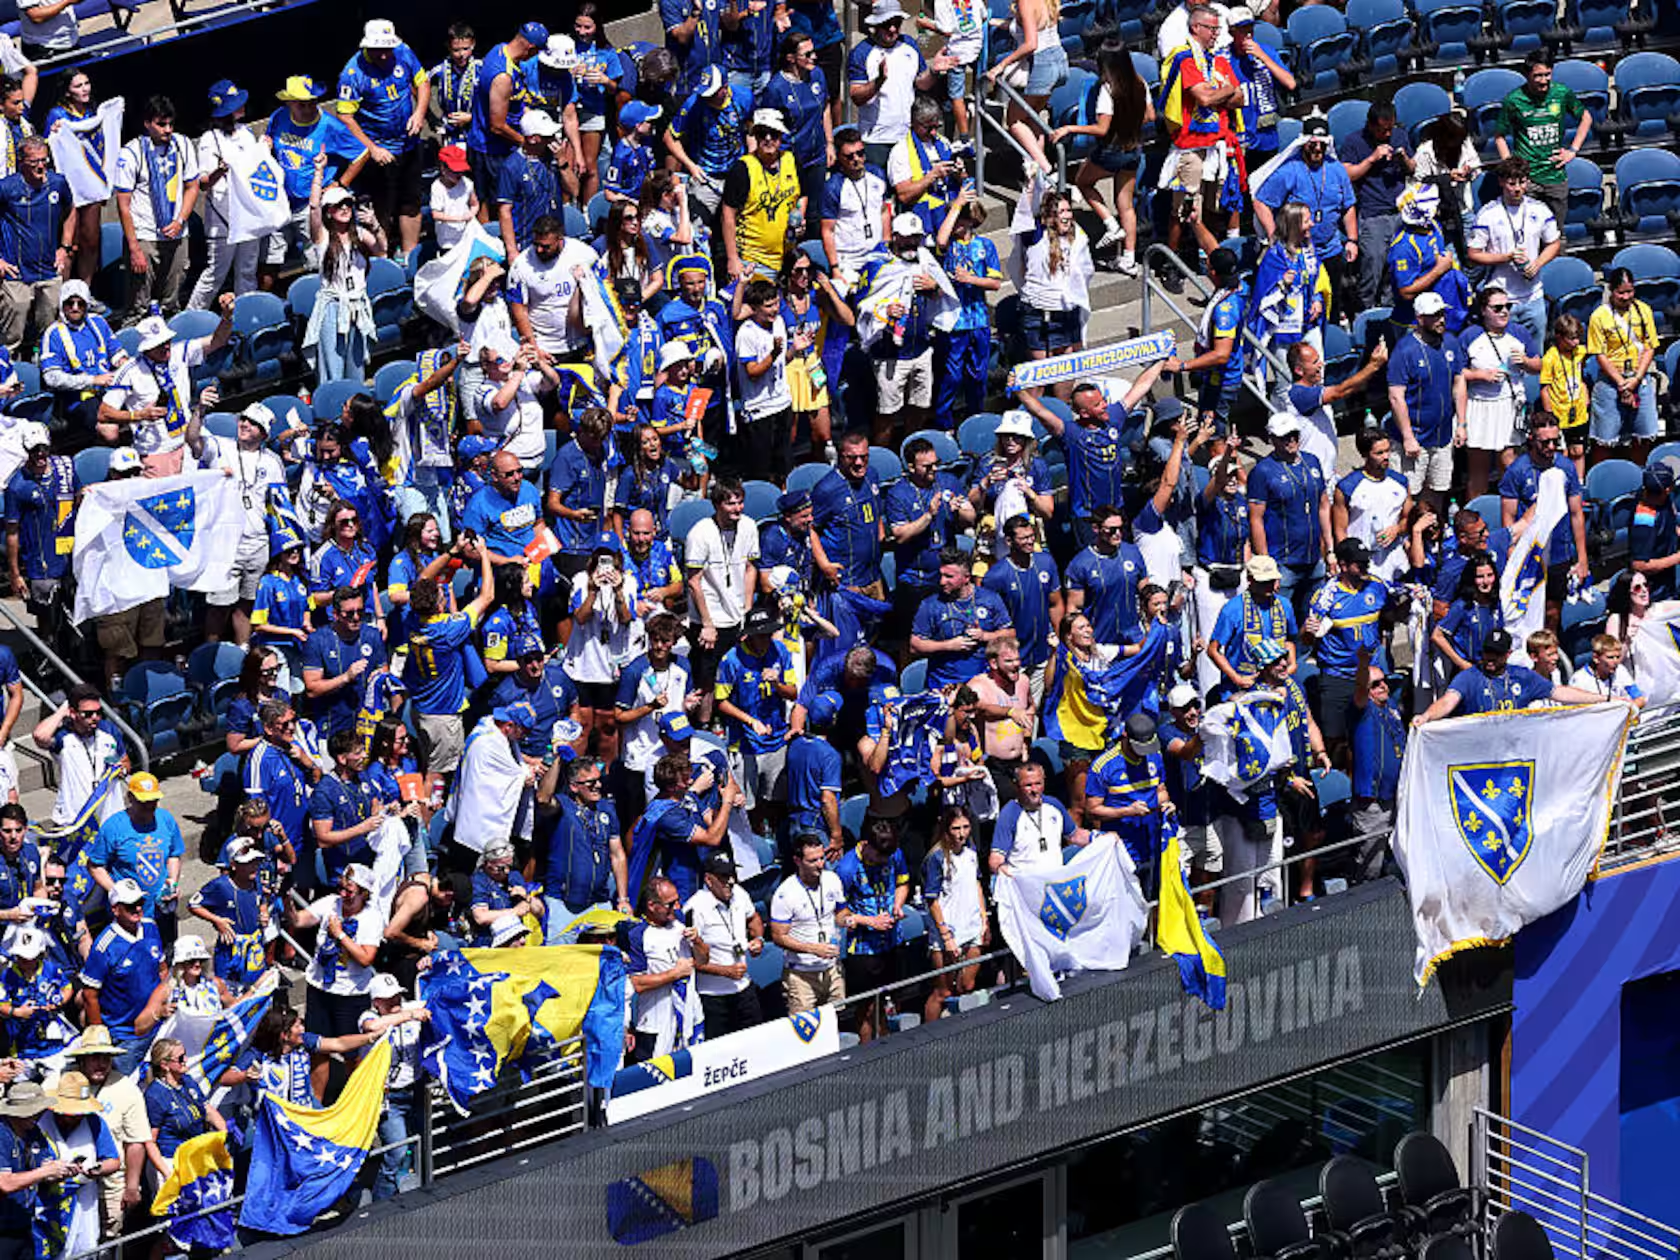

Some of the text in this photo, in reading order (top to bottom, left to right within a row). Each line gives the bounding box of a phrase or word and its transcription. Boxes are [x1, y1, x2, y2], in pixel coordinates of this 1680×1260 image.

[555, 281, 571, 297] 20
[862, 502, 875, 524] 11
[758, 681, 772, 700] 11
[704, 1057, 748, 1087] ŽEPČE
[728, 944, 1365, 1213] BOSNIA AND HERZEGOVINA
